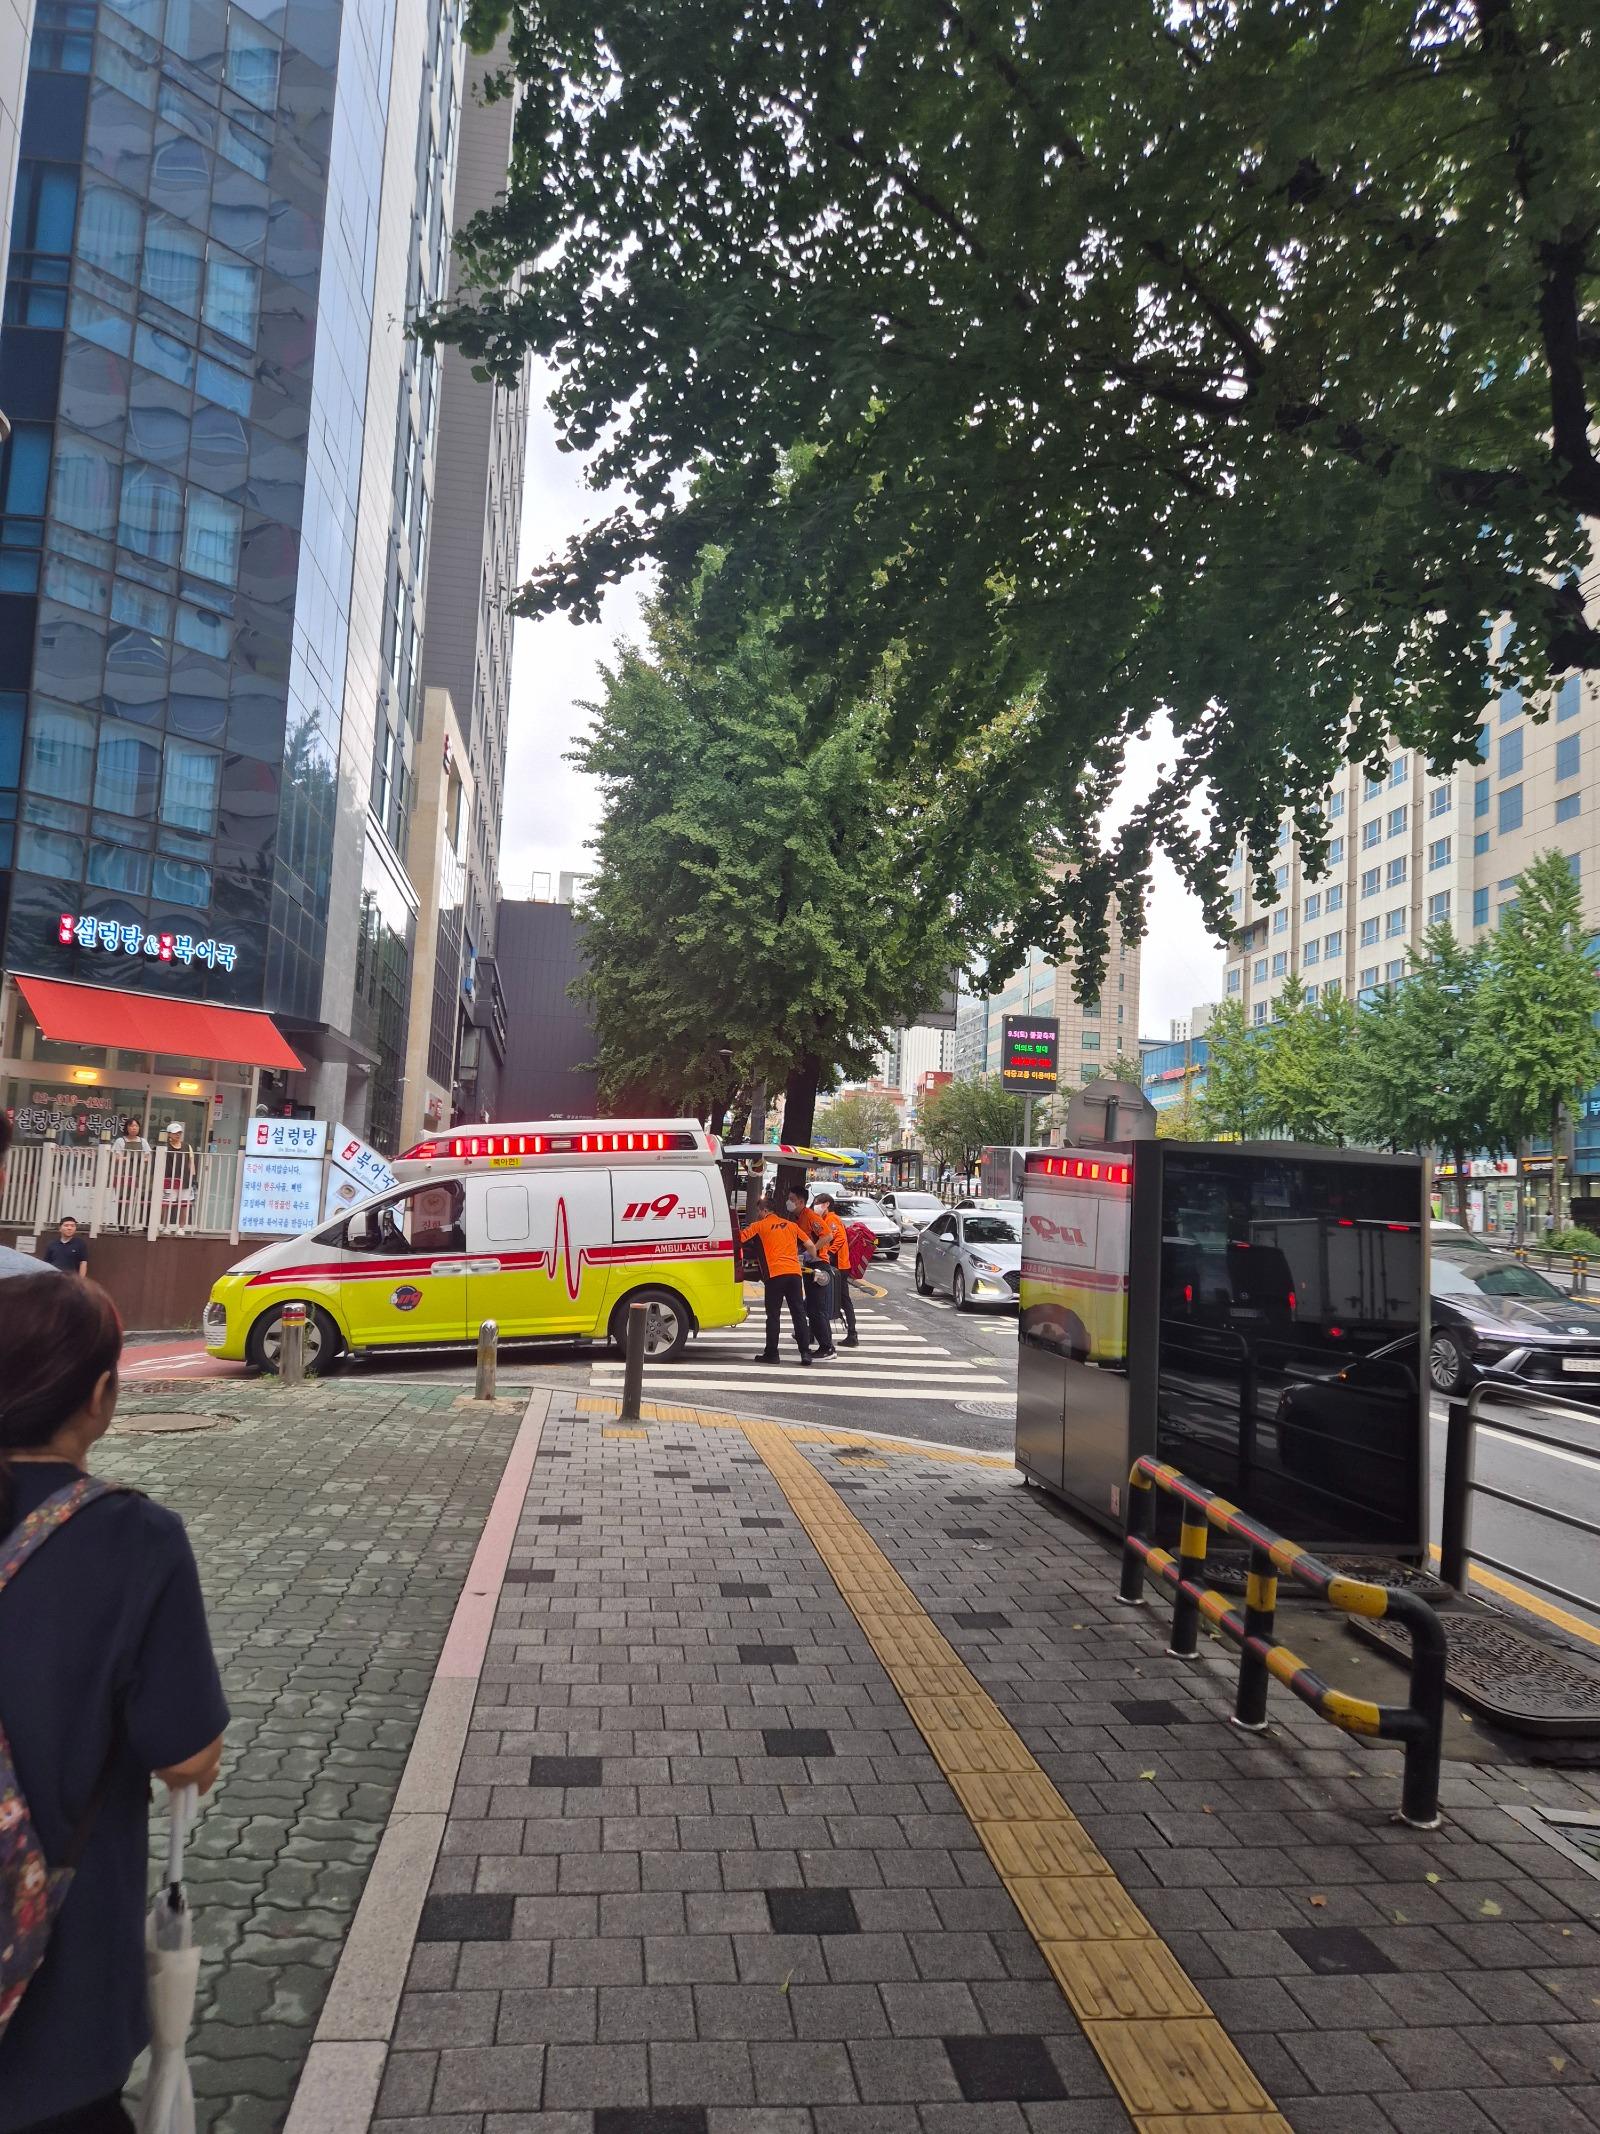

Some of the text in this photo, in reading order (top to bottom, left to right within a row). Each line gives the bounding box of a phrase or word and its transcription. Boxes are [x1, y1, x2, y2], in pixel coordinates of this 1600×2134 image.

[74, 915, 144, 955] 설렁탕
[172, 934, 238, 973] 북어국
[271, 1126, 317, 1146] 설렁탕
[621, 1193, 707, 1221] 119 구급대
[770, 1222, 787, 1231] 119
[654, 1242, 708, 1254] AMBULANCE
